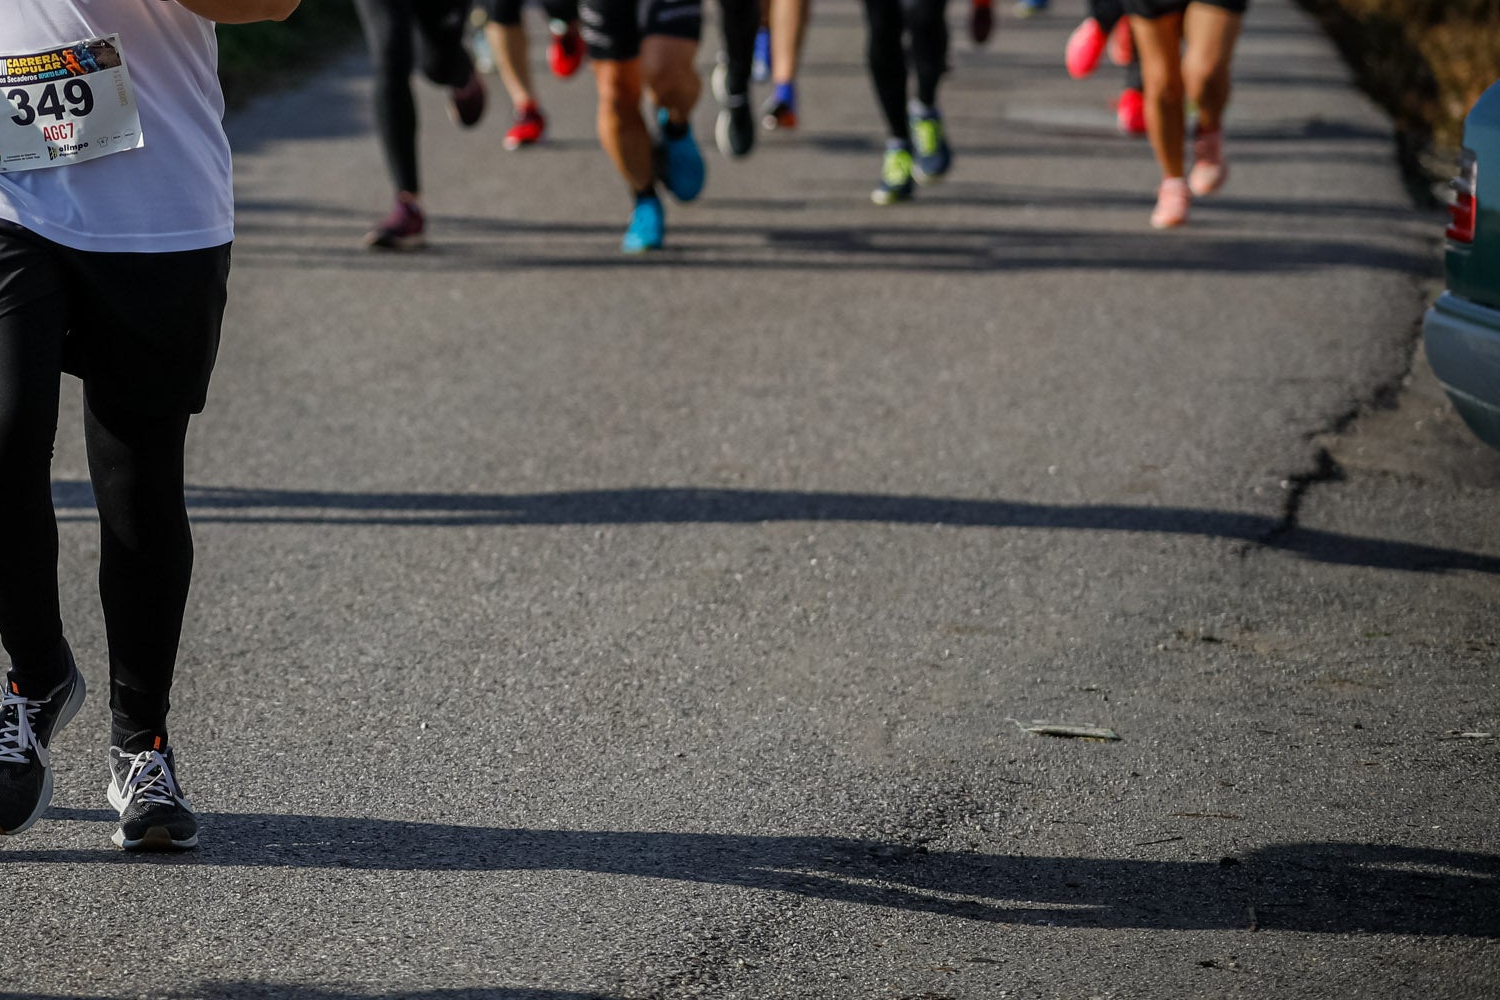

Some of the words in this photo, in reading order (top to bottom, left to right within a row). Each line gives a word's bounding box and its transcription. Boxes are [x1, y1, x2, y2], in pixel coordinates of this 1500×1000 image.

[7, 53, 60, 67] CARRERA
[7, 61, 62, 75] POPULAR
[6, 74, 38, 83] Secaderos
[7, 78, 94, 127] 349
[43, 122, 75, 142] AGC7
[58, 142, 89, 152] olimpo
